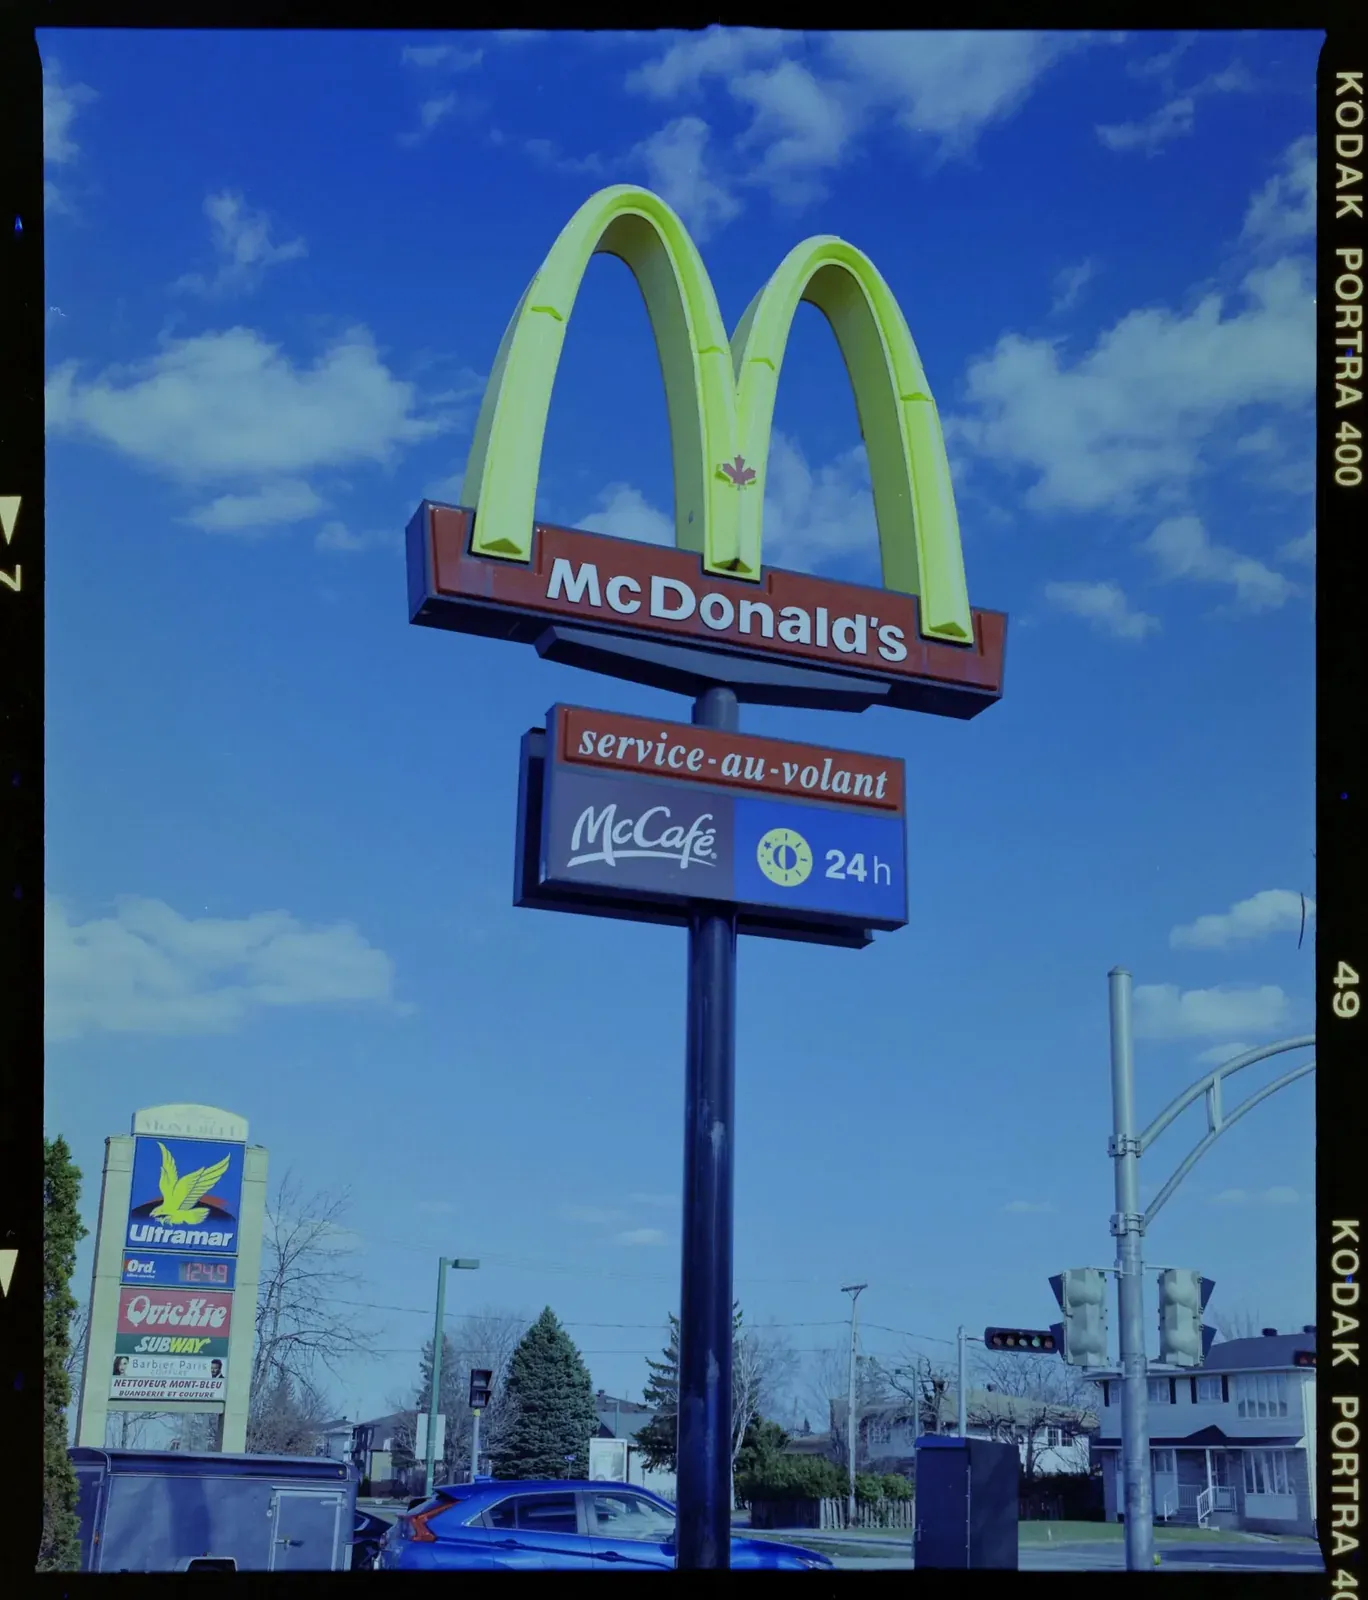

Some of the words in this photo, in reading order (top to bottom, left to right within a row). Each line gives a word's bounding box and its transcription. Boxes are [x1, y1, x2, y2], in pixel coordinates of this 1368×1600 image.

[1335, 71, 1364, 219] KODAK
[1334, 248, 1364, 409] PORTRA
[1334, 421, 1363, 487] 400
[546, 558, 908, 663] McDonald's
[578, 729, 888, 800] service-au-volant
[567, 803, 717, 869] McCafé
[824, 849, 868, 882] 24
[873, 855, 892, 886] h
[1332, 960, 1361, 1018] 49
[127, 1259, 156, 1274] Ord.
[129, 1224, 233, 1247] Ultramar
[1331, 1219, 1360, 1367] KODAK
[132, 1359, 173, 1369] Barbier
[179, 1360, 207, 1371] Paris
[134, 1336, 211, 1353] SUBWAY
[113, 1379, 167, 1388] NETTOYEUR
[169, 1380, 222, 1389] MONT-BLEU
[179, 1391, 215, 1399] COUTURE
[1331, 1396, 1360, 1556] PORTRA
